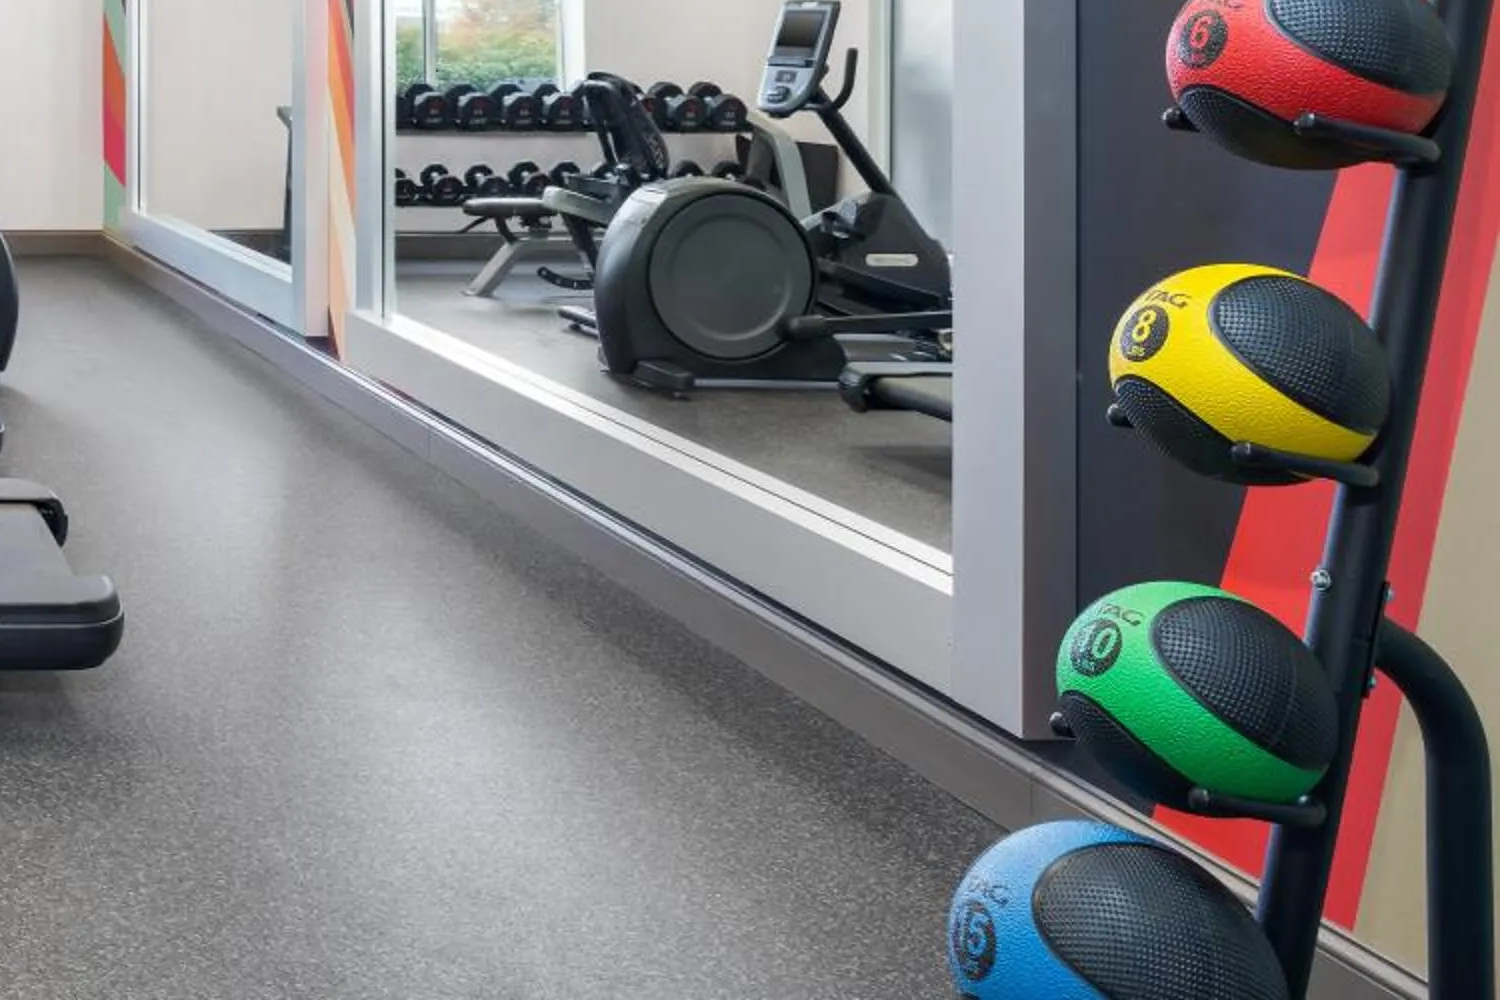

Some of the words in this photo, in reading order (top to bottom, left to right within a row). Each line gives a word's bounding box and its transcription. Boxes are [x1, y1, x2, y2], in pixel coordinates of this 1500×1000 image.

[1189, 15, 1211, 49] 6
[1131, 309, 1157, 342] 8
[1078, 625, 1118, 659] 10
